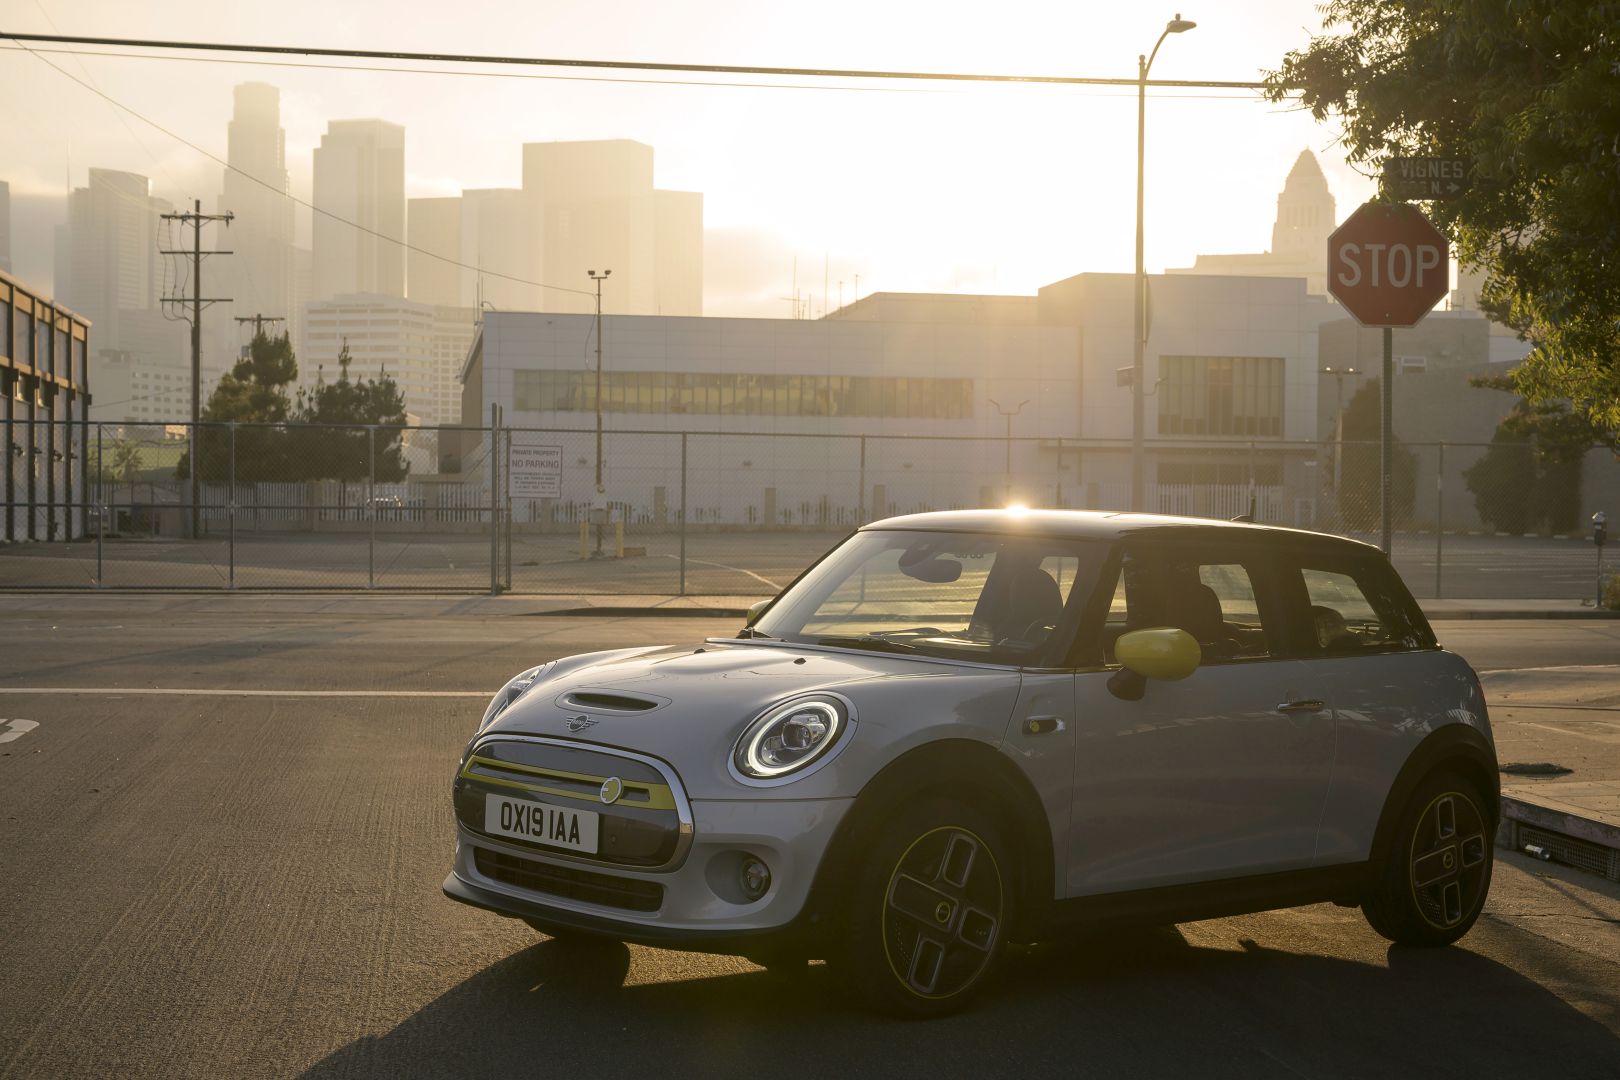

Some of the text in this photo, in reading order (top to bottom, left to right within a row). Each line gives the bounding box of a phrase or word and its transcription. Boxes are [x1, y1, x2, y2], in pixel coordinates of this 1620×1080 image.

[1399, 160, 1464, 178] VIGNES
[1338, 242, 1440, 288] STOP
[511, 459, 559, 469] NO PARKING
[500, 801, 544, 837] OX19
